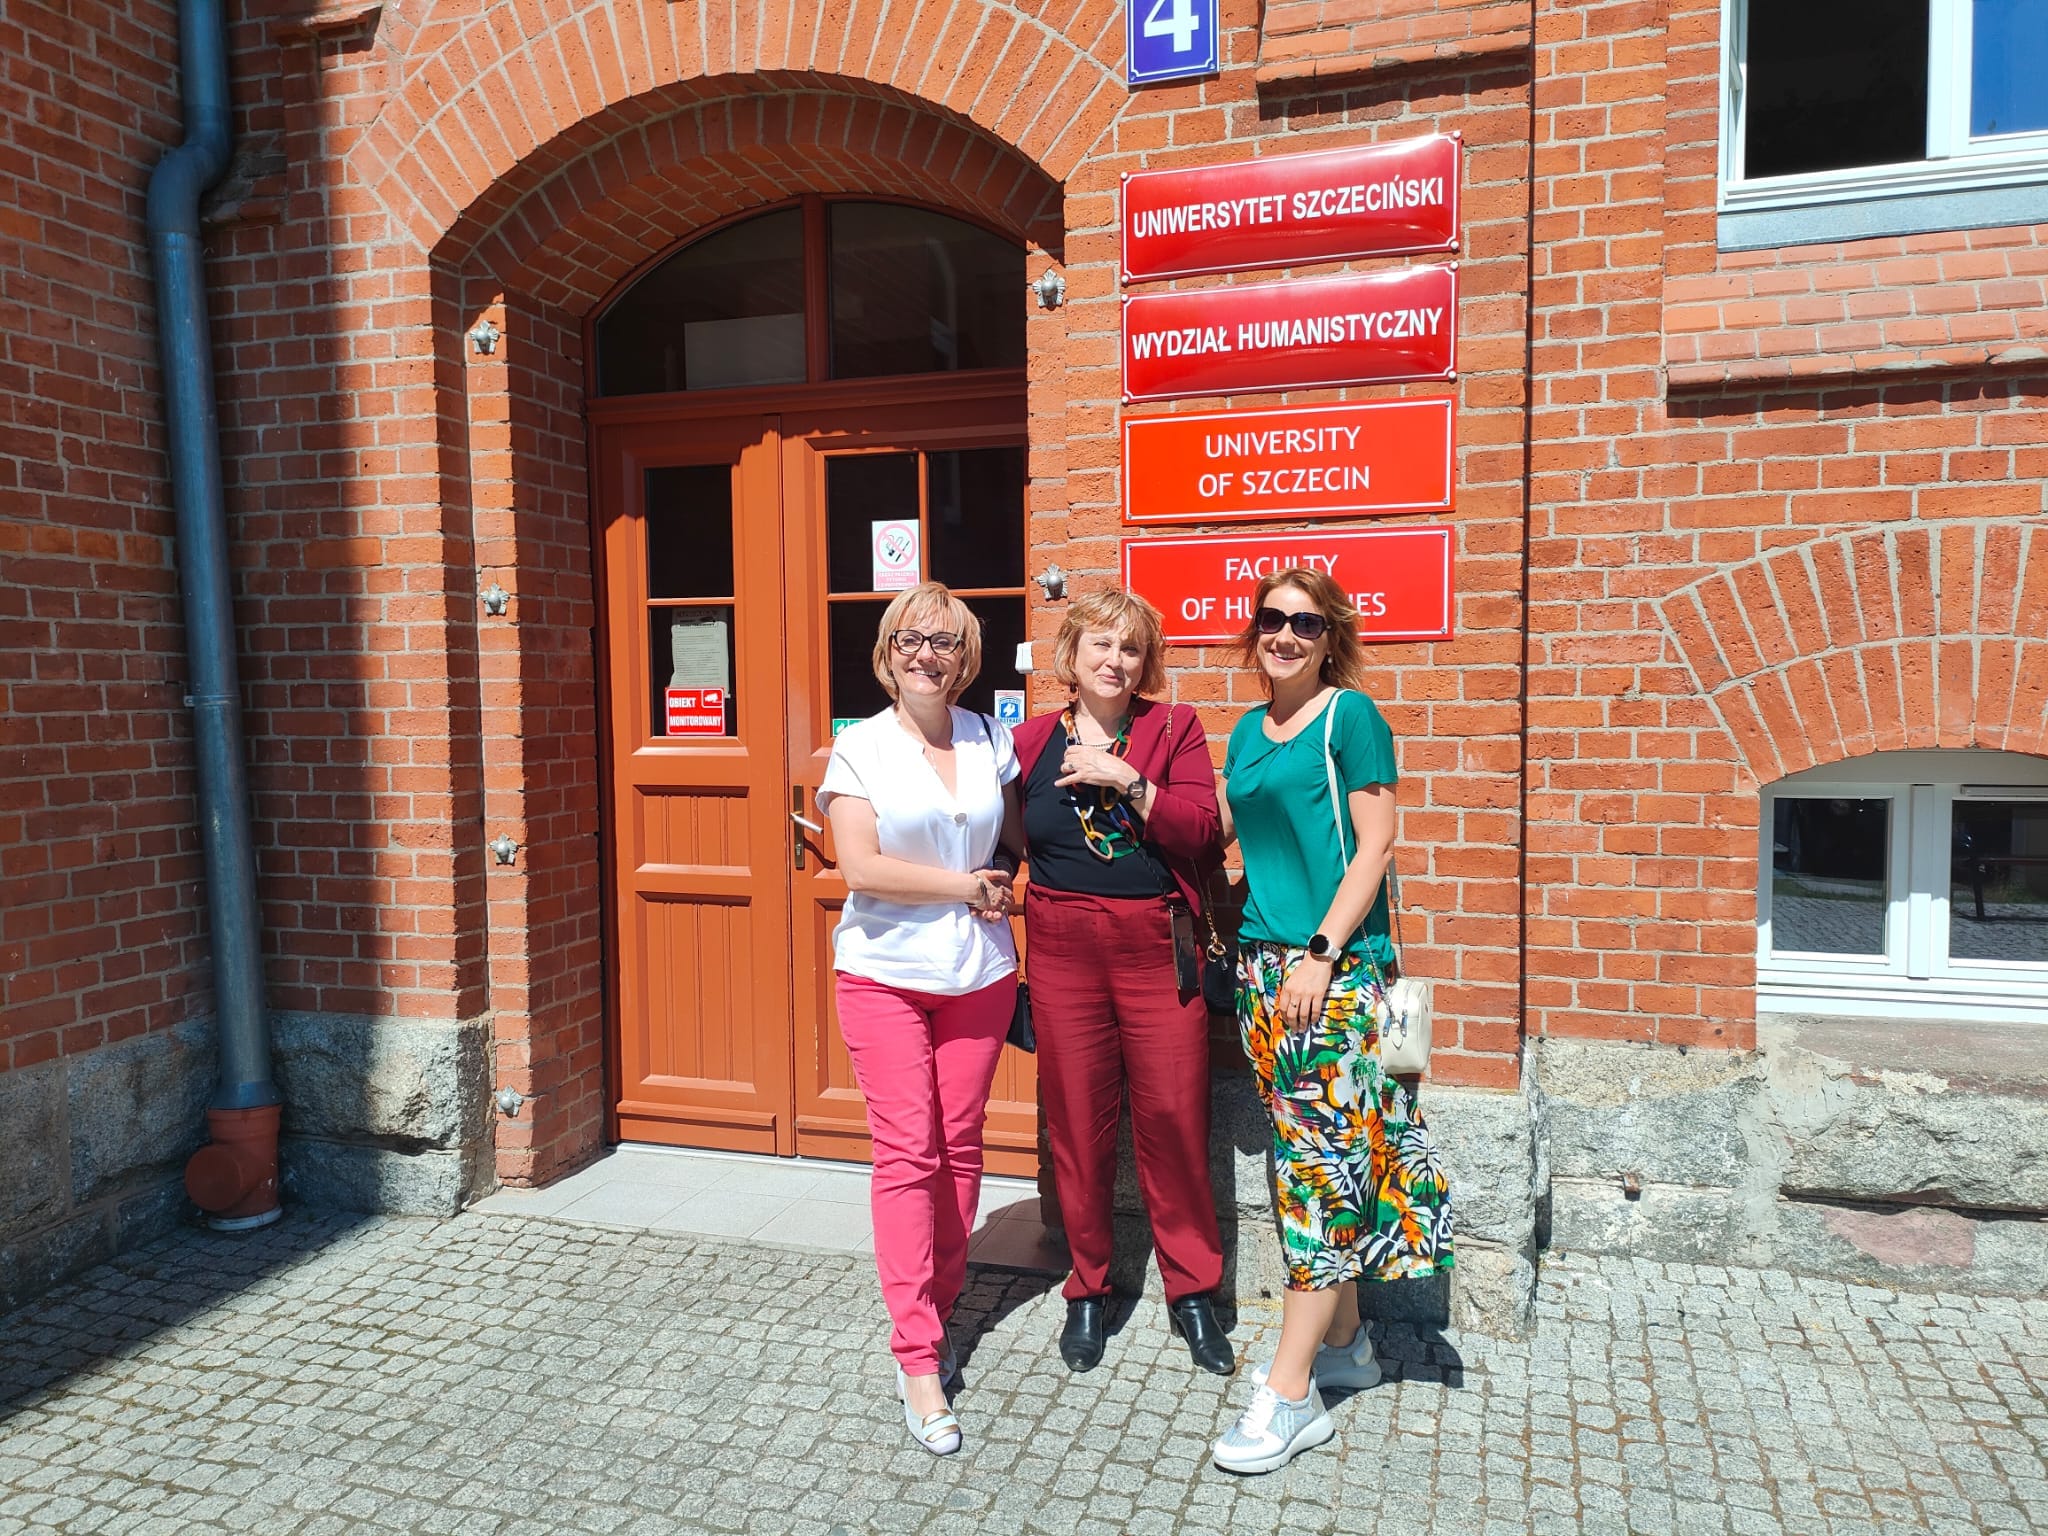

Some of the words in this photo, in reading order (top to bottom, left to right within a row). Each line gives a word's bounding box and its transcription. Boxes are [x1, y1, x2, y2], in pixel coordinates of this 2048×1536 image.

[1143, 0, 1199, 53] 4
[1133, 194, 1286, 238] UNIWERSYTET
[1292, 174, 1443, 219] SZCZECIŃSKI
[1132, 325, 1232, 360] WYDZIAŁ
[1238, 307, 1443, 350] HUMANISTYCZNY
[1205, 426, 1361, 458] UNIVERSITY
[1198, 473, 1234, 498] OF
[1242, 466, 1370, 495] SZCZECIN
[1181, 597, 1217, 621] OF
